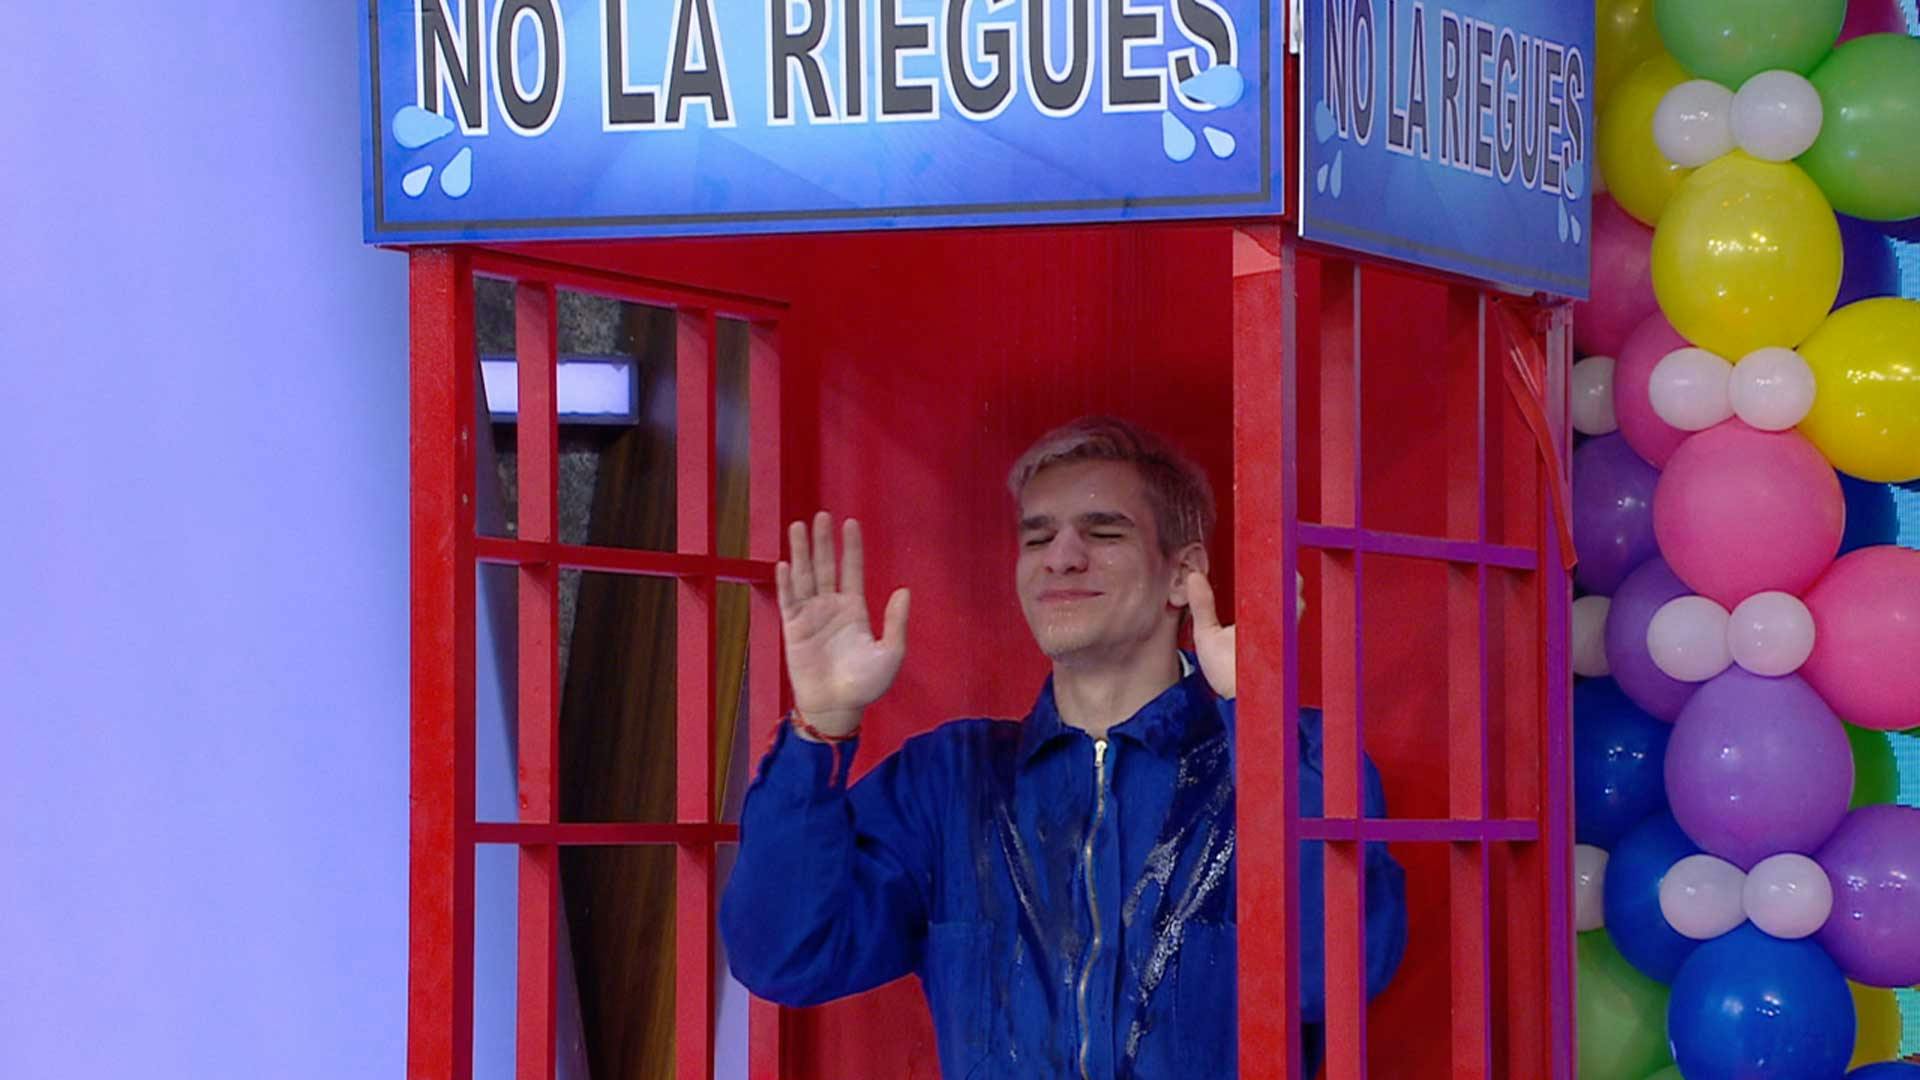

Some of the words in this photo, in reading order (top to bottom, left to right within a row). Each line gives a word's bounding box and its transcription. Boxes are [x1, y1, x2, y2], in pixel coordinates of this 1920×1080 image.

[416, 0, 566, 137] NO
[601, 0, 738, 132] LA
[766, 0, 1239, 126] RIEGUES
[1323, 0, 1376, 146] NO
[1386, 0, 1431, 161] LA
[1440, 9, 1584, 200] RIEGUES
